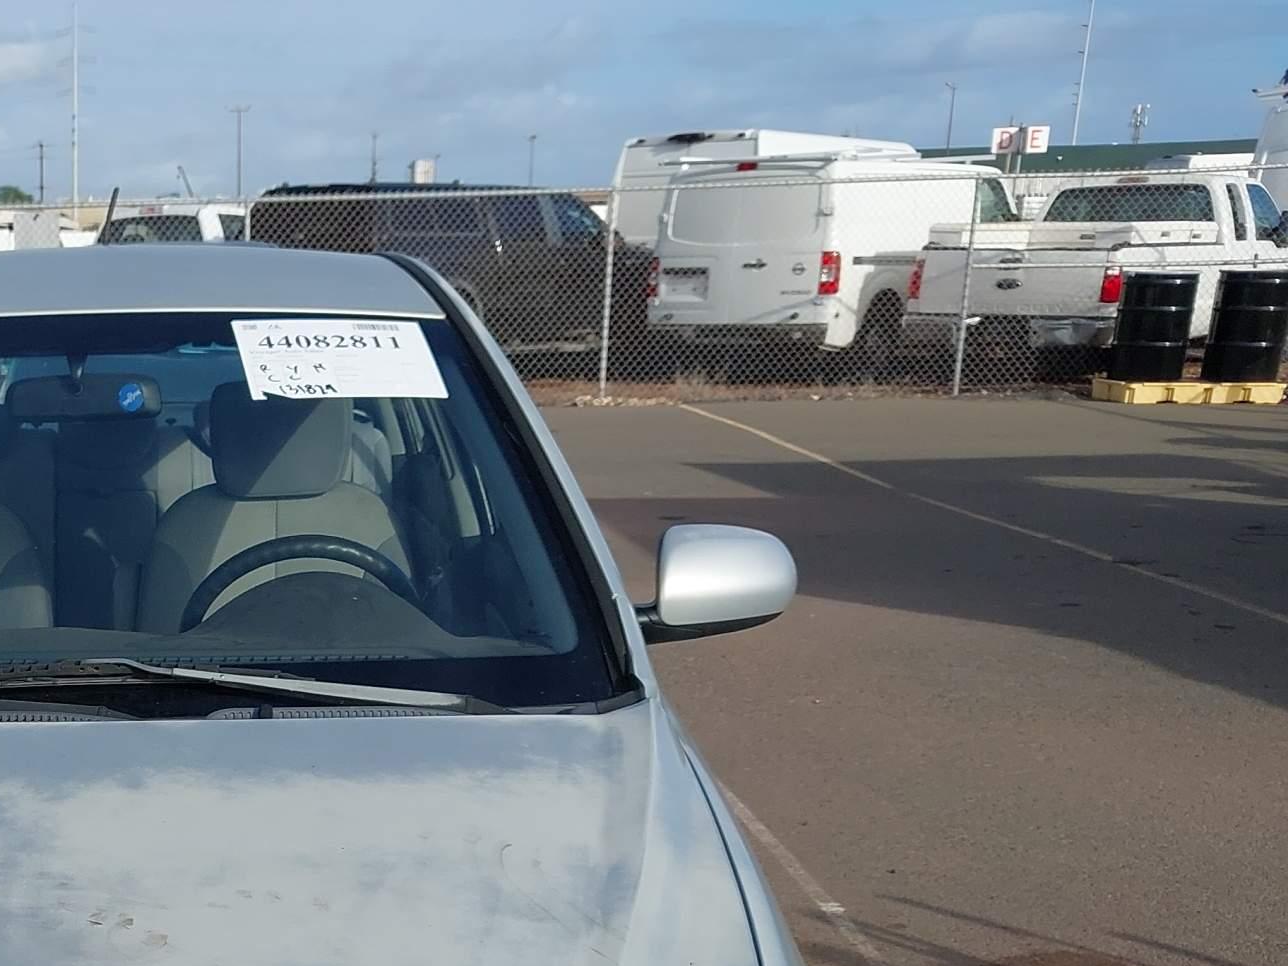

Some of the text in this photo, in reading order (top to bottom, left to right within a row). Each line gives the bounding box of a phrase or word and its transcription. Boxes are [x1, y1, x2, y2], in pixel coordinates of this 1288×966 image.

[999, 131, 1013, 149] D
[1030, 130, 1043, 148] E
[258, 334, 400, 349] 44082811
